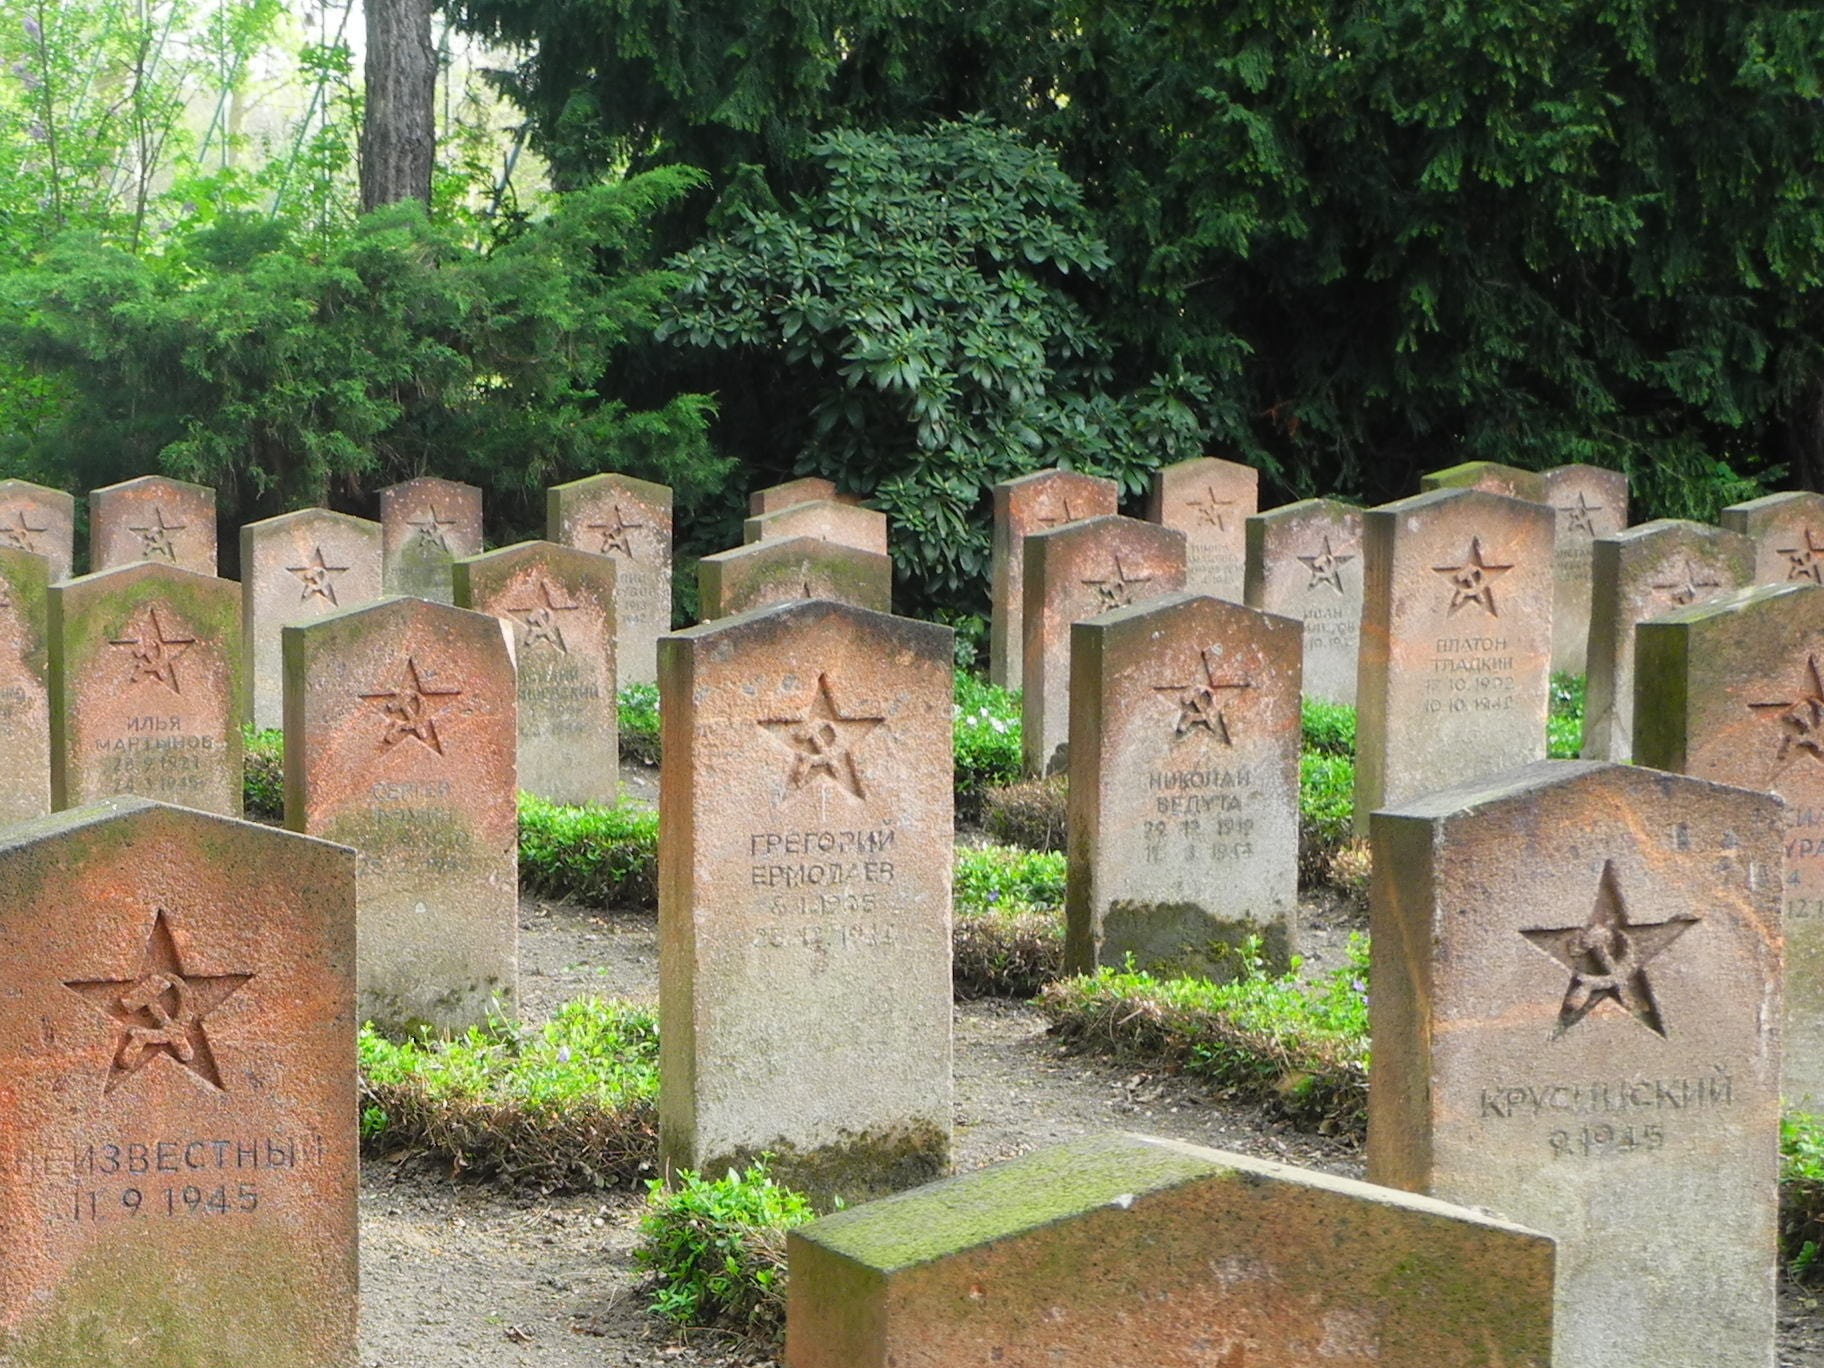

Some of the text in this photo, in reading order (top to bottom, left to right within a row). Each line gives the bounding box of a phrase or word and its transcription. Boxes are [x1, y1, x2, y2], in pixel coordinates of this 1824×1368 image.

[1436, 637, 1507, 653] ПЛАТОН
[126, 715, 181, 732] ИЛЬЯ
[95, 735, 213, 751] МАРТЫНОВ
[751, 861, 895, 888] ЕРМОЛАЕВ
[122, 1187, 144, 1217] 9
[162, 1182, 259, 1218] 1945
